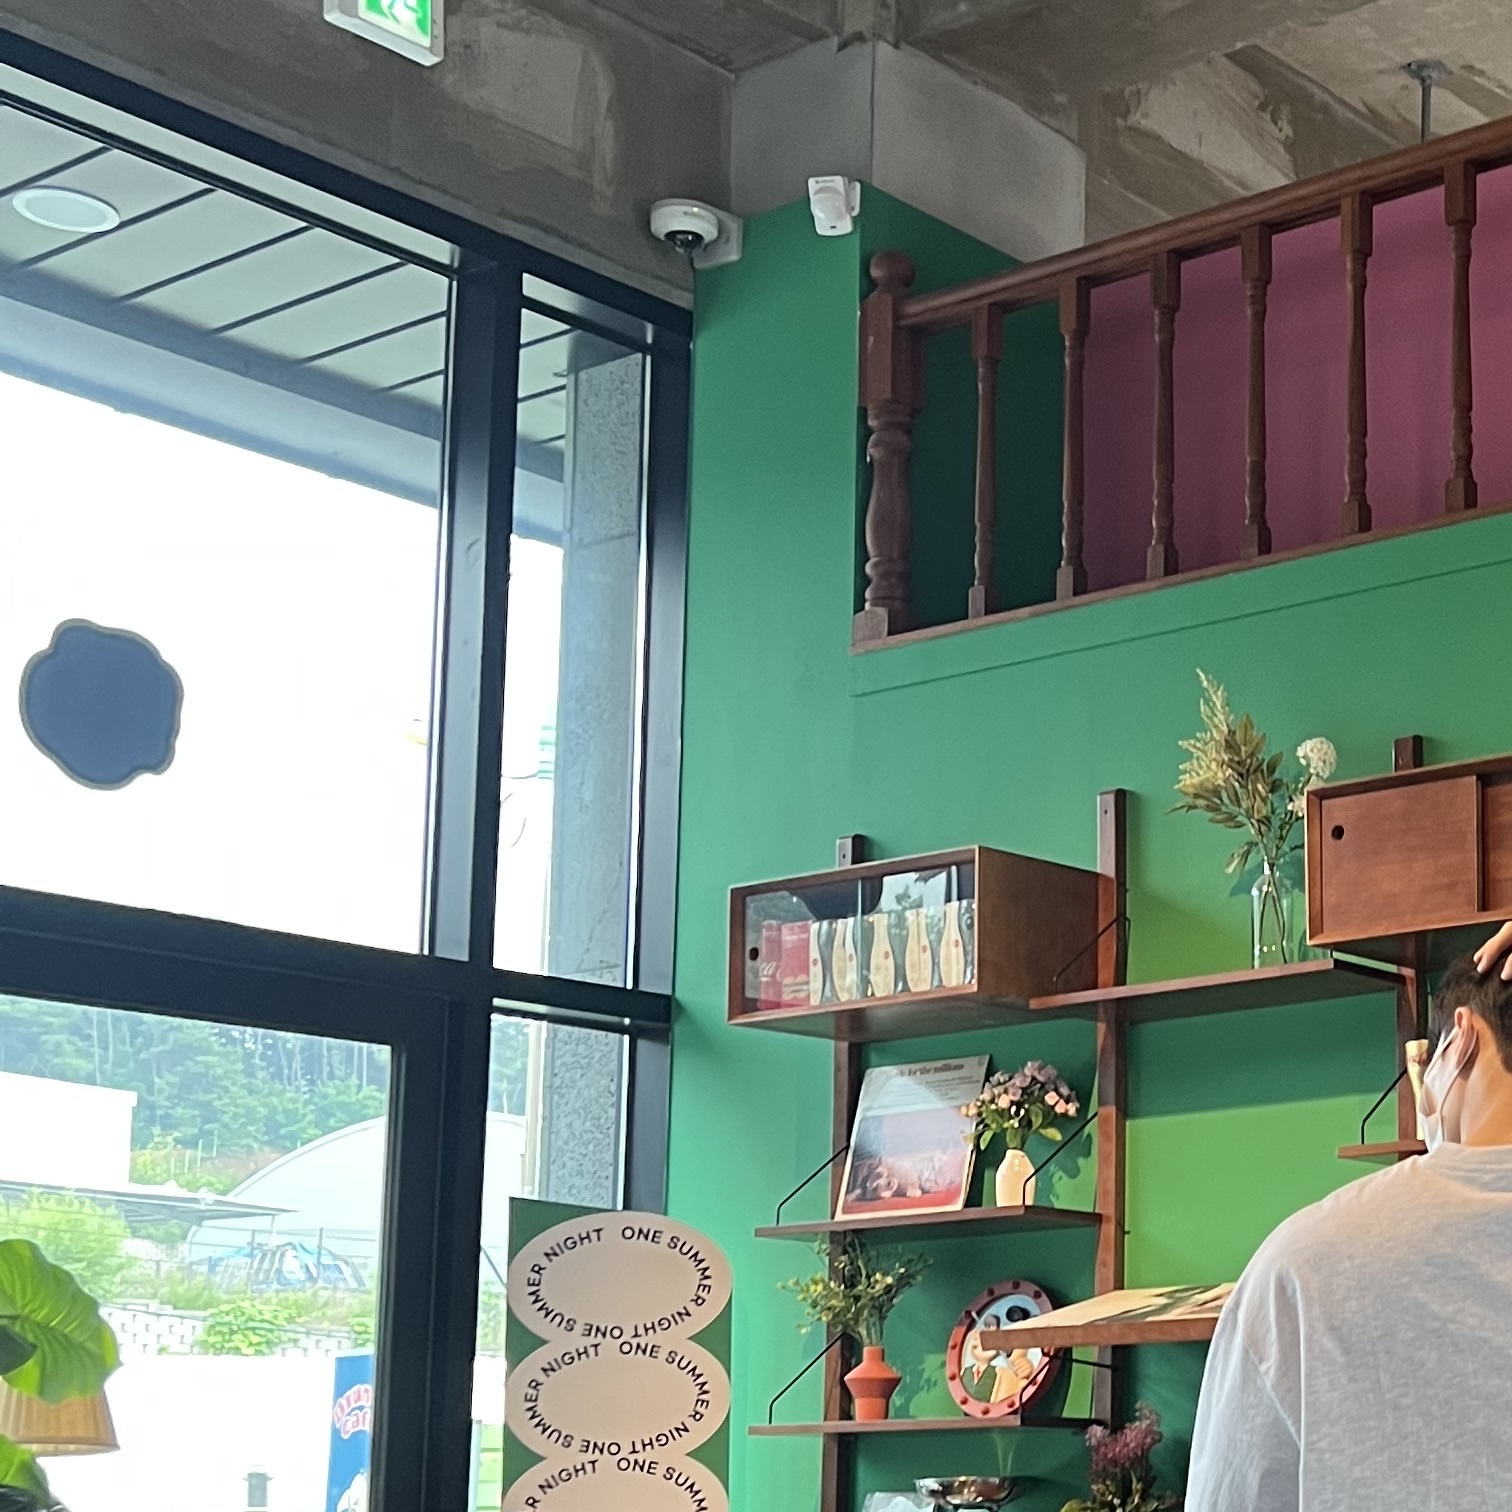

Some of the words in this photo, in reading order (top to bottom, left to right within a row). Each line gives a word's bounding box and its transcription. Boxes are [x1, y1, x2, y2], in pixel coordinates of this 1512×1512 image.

[543, 1227, 604, 1263] NIGHT
[621, 1226, 664, 1244] ONE
[667, 1235, 712, 1307] SUMMER
[527, 1263, 577, 1332] SUMMER
[581, 1322, 623, 1340] ONE
[630, 1306, 692, 1339] NIGHT
[540, 1342, 601, 1378] NIGHT
[618, 1341, 662, 1359] ONE
[665, 1350, 711, 1422] SUMMER
[524, 1378, 574, 1448] SUMMER
[578, 1439, 621, 1456] ONE
[629, 1421, 690, 1454] NIGHT
[538, 1459, 599, 1495] NIGHT
[616, 1457, 660, 1475] ONE
